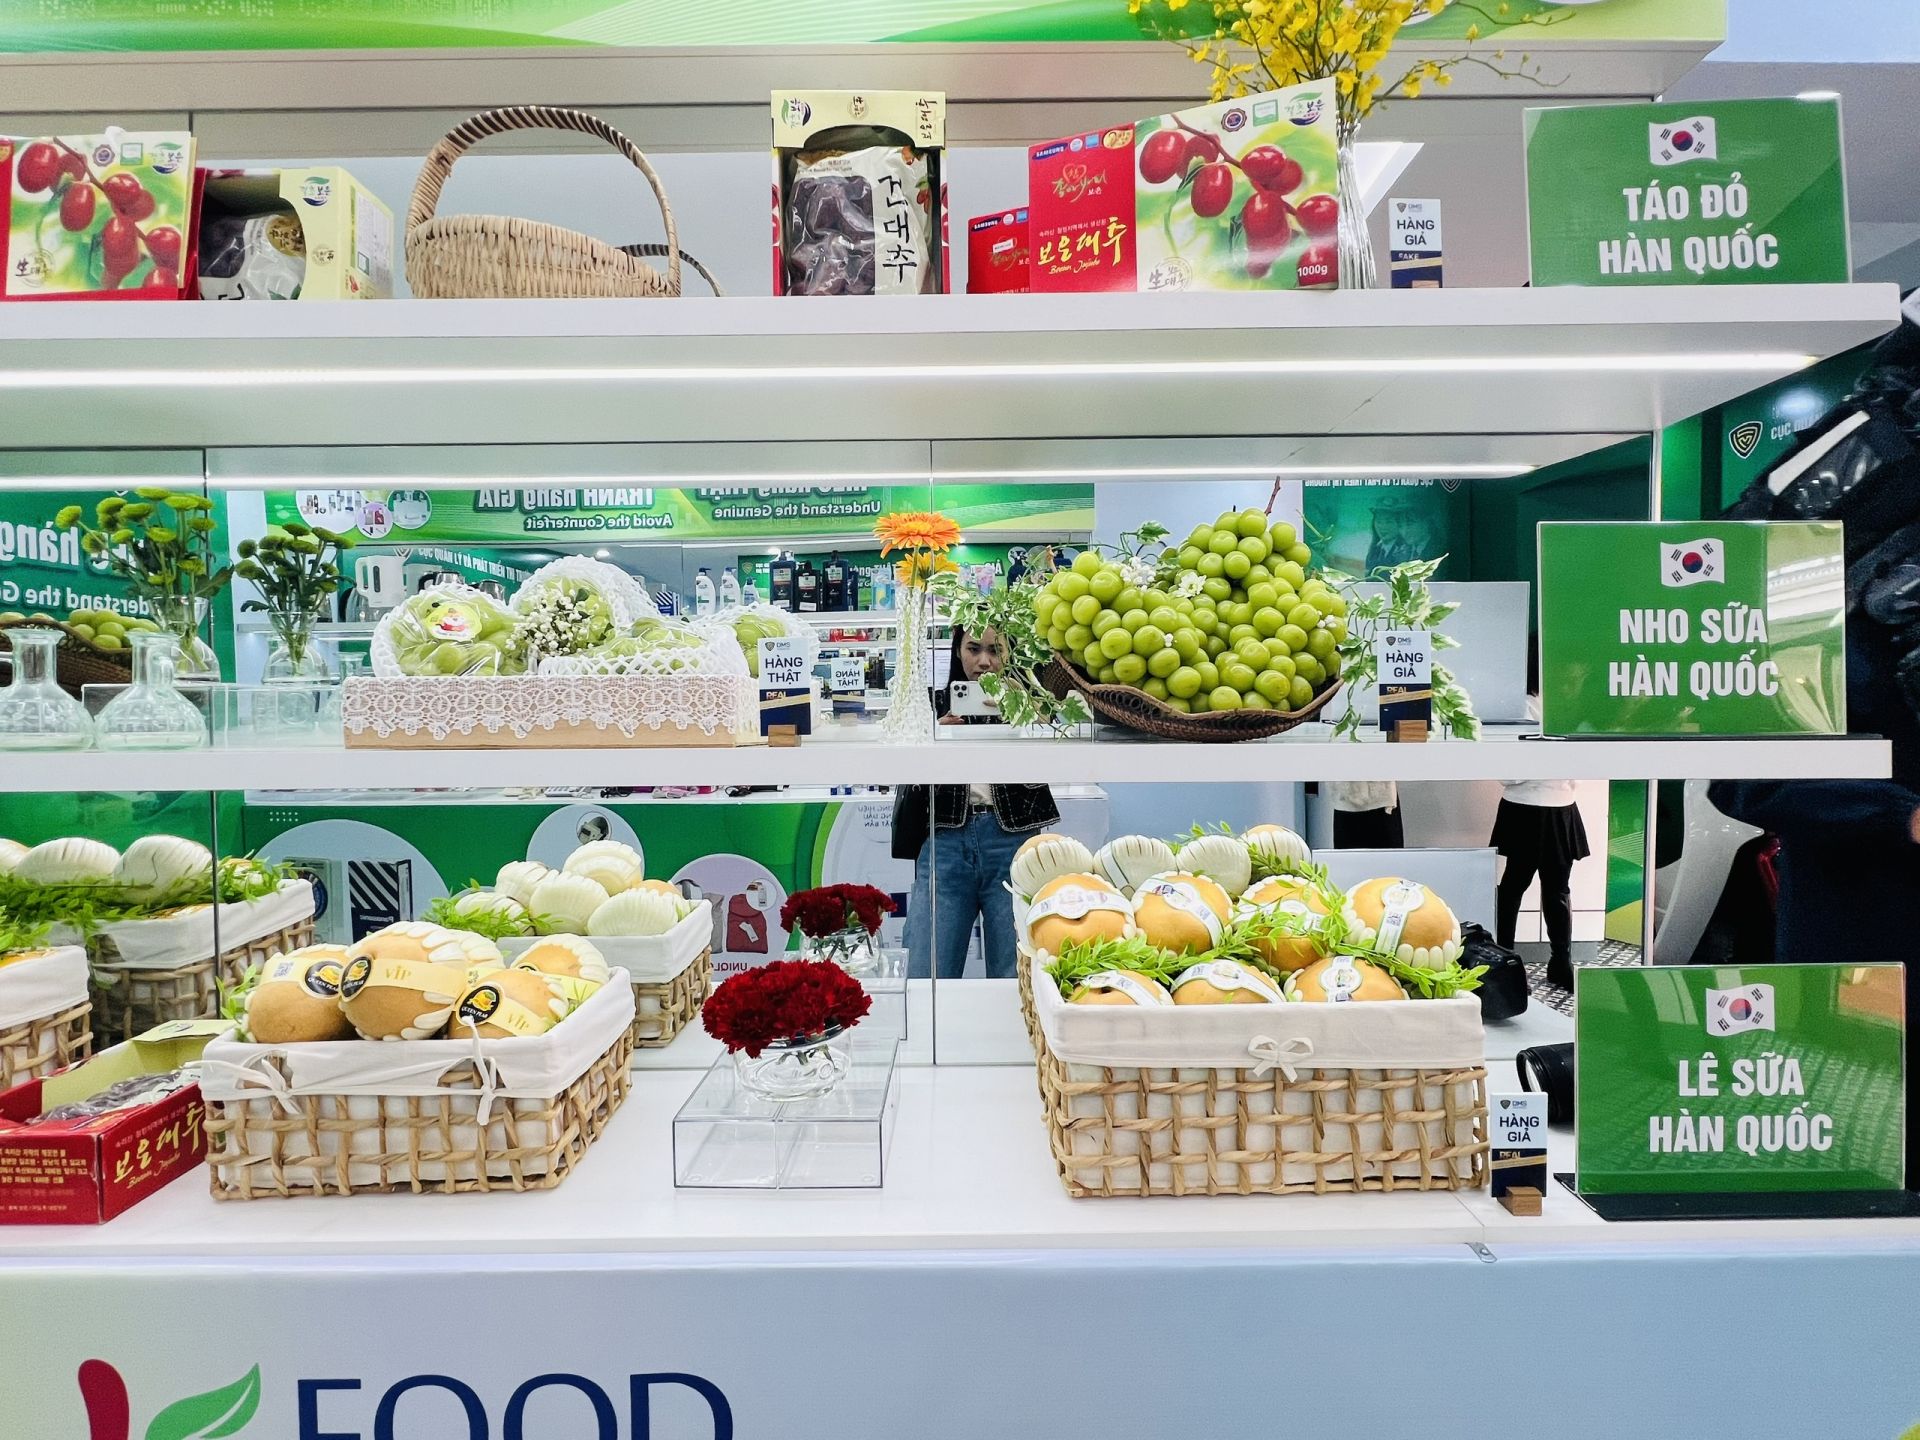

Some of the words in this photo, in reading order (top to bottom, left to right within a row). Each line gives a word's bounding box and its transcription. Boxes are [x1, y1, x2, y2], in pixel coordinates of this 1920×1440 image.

[1622, 179, 1689, 222] TÁO
[1702, 171, 1748, 219] ĐỎ
[1396, 216, 1435, 230] HÀNG
[1038, 216, 1128, 267] 보은대추
[1405, 231, 1427, 246] GIẢ
[1599, 231, 1672, 275] HÀN
[1684, 222, 1779, 275] QUỐC
[1297, 264, 1328, 277] 1000g
[1770, 422, 1792, 441] CỤC
[1619, 609, 1689, 644] NHO
[1700, 601, 1768, 644] SỮA
[765, 654, 803, 669] HÀNG
[1386, 649, 1424, 663] HÀNG
[767, 669, 802, 685] THẬT
[1393, 663, 1417, 678] GIẢ
[1608, 654, 1679, 697] HÀN
[1690, 648, 1779, 700] QUỐC
[1678, 1051, 1719, 1098] LÊ
[1732, 1051, 1803, 1096] SỮA
[1499, 1113, 1540, 1128] HÀNG
[1649, 1108, 1724, 1153] HÀN
[1737, 1101, 1833, 1156] QUỐC
[1507, 1128, 1532, 1142] GIẢ
